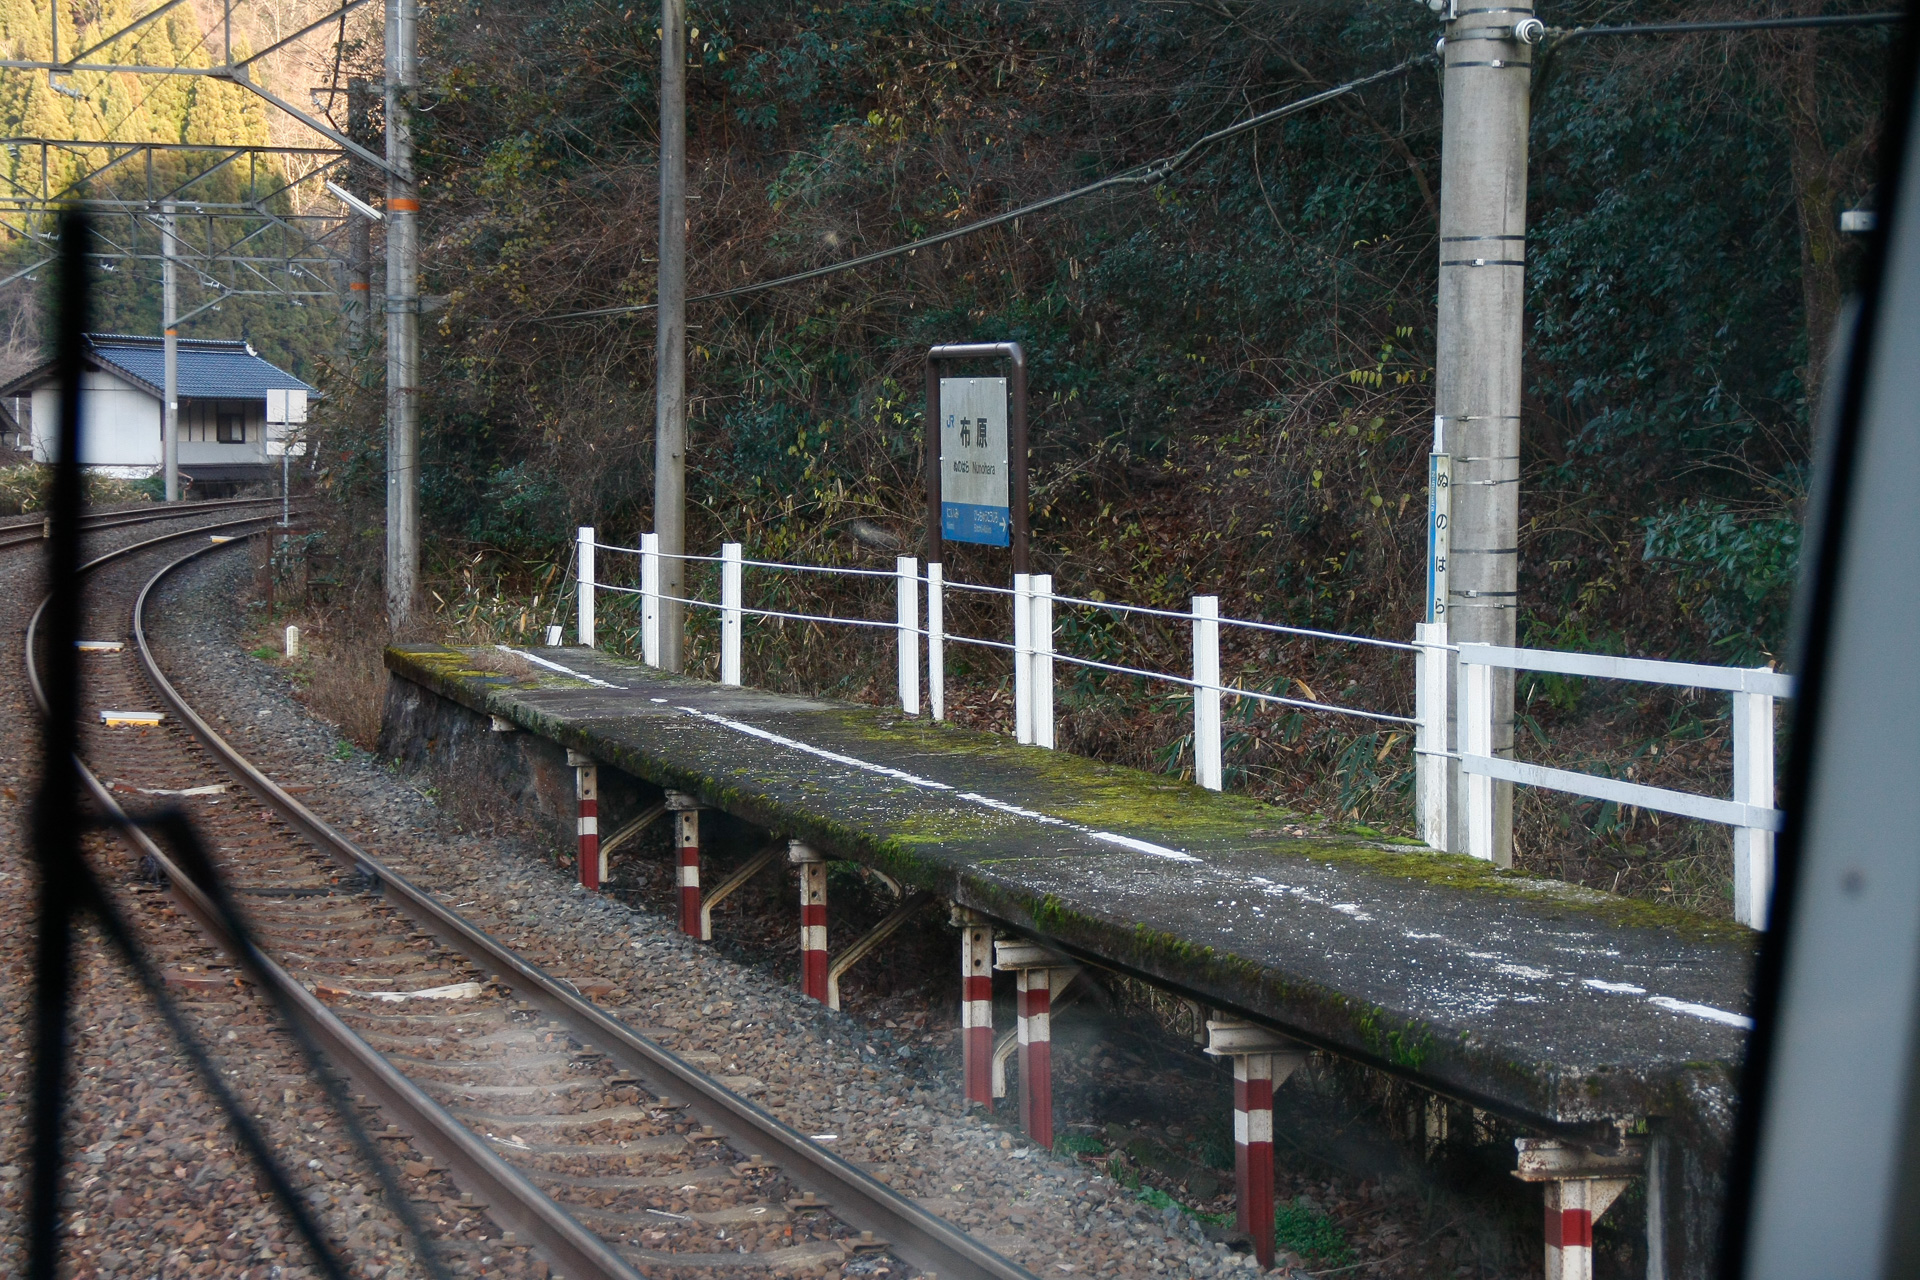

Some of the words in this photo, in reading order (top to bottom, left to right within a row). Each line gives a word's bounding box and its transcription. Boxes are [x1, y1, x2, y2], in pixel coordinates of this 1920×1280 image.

[946, 415, 955, 428] JR
[960, 416, 988, 448] 布原
[953, 461, 969, 473] ぬのはら
[972, 461, 996, 475] Nunohara
[1435, 472, 1448, 614] ぬのはら
